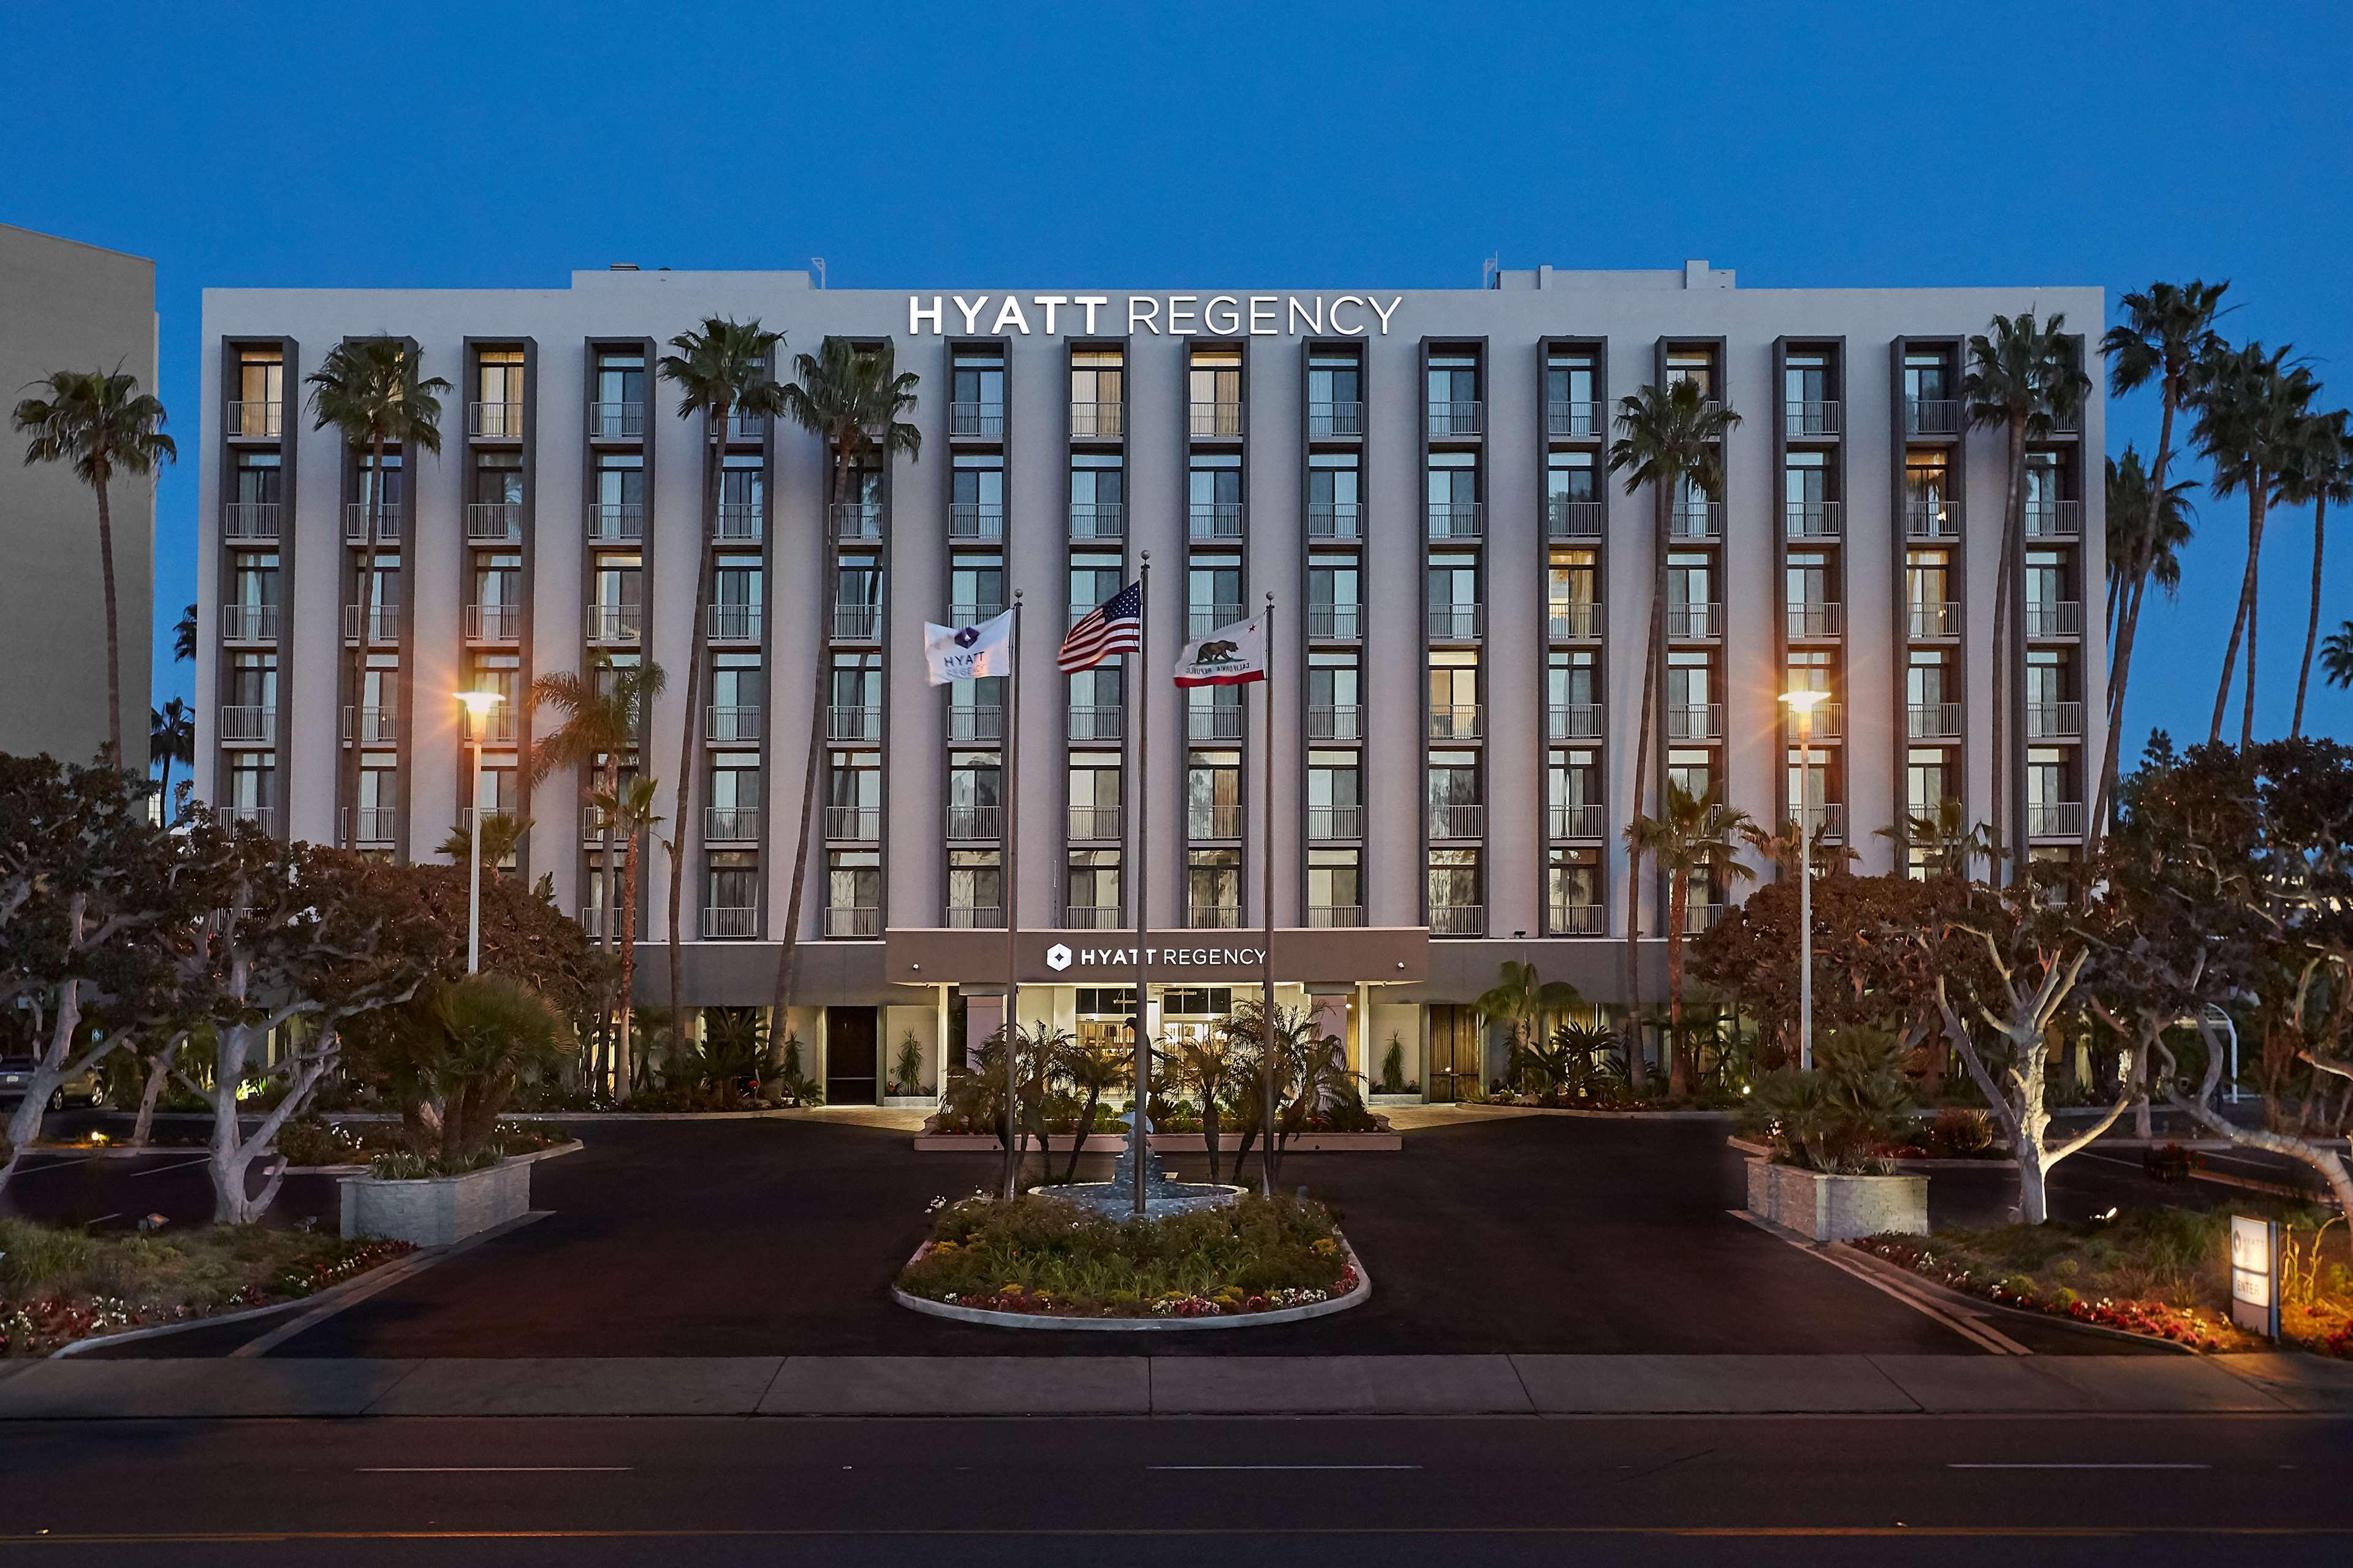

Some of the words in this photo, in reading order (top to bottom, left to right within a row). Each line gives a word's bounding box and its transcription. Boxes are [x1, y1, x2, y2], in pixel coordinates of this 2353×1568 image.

[910, 296, 1108, 335] HYATT
[1129, 295, 1402, 335] REGENCY
[945, 651, 985, 667] HYATT
[1081, 949, 1157, 964] HYATT
[1164, 949, 1266, 964] REGENCY
[2237, 1280, 2260, 1297] ENTER
